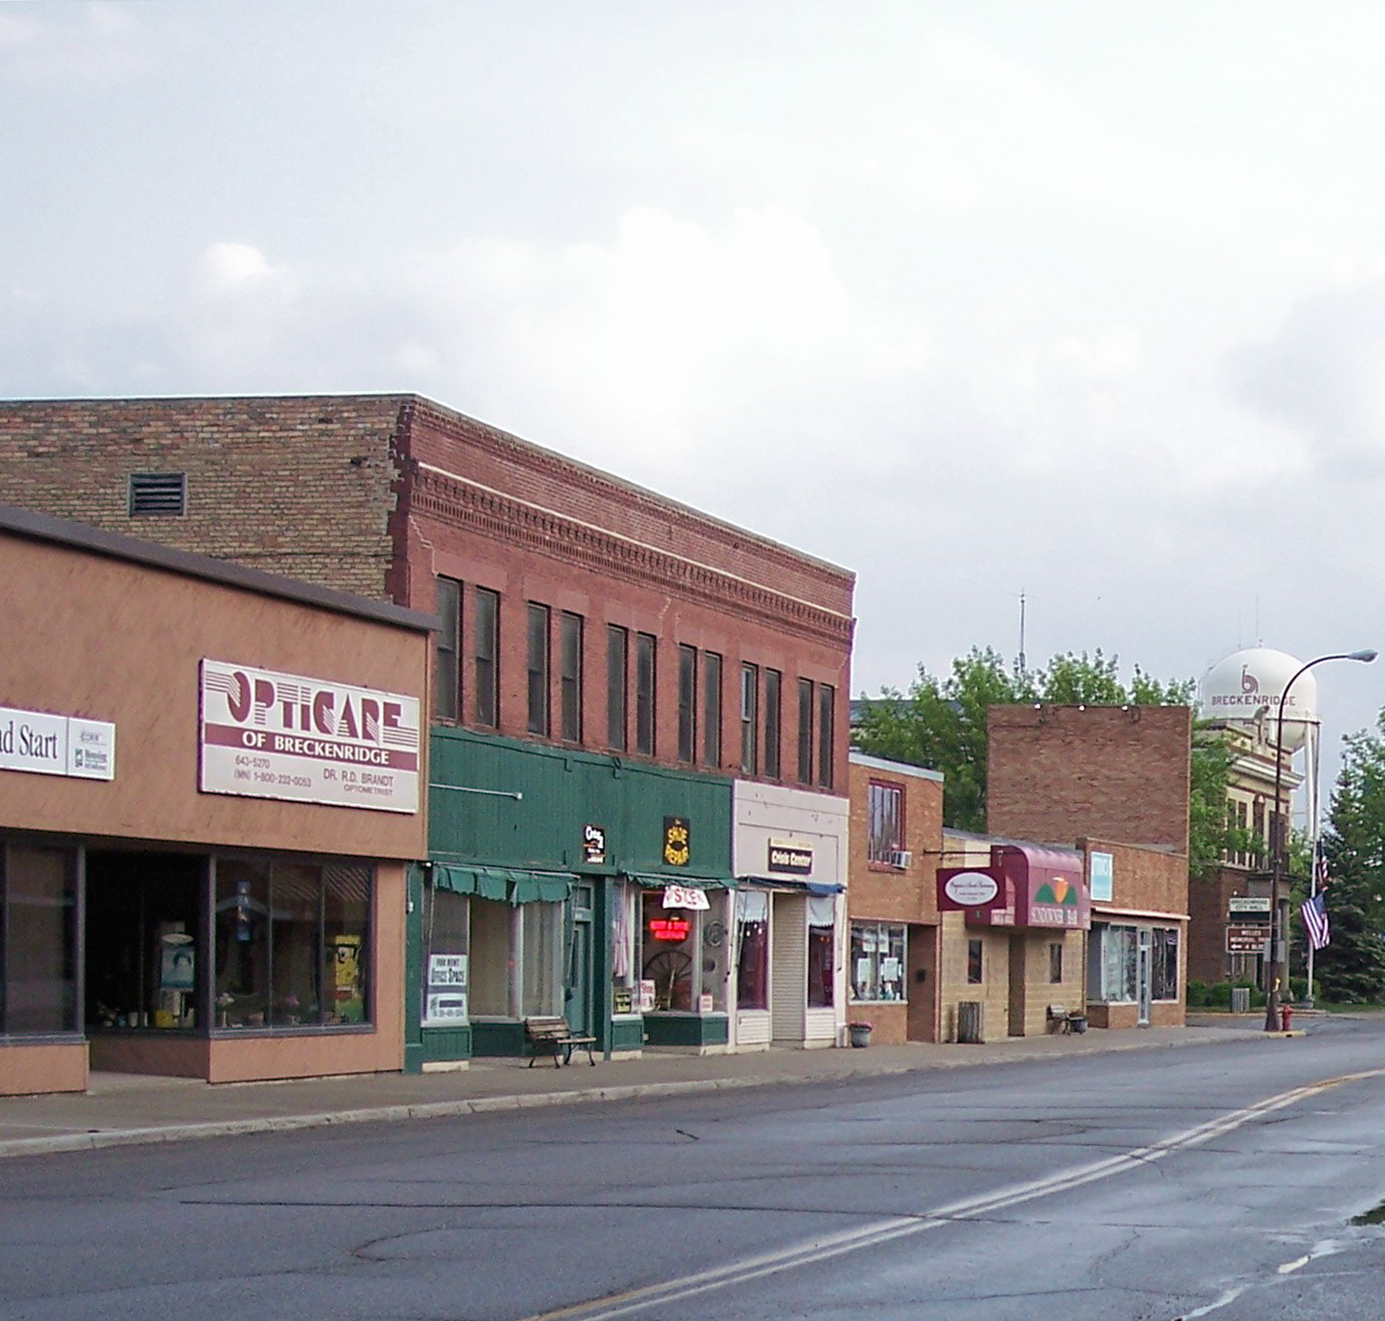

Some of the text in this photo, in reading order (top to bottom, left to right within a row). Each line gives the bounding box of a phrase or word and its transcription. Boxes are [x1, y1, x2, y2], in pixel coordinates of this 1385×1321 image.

[226, 671, 402, 745] OPTICARE
[19, 724, 57, 759] Start
[242, 731, 390, 765] OF BRECKENRIDGE
[344, 784, 393, 796] OPTOMETRIST
[361, 772, 394, 787] BRANDT
[771, 850, 811, 867] Crisis Center
